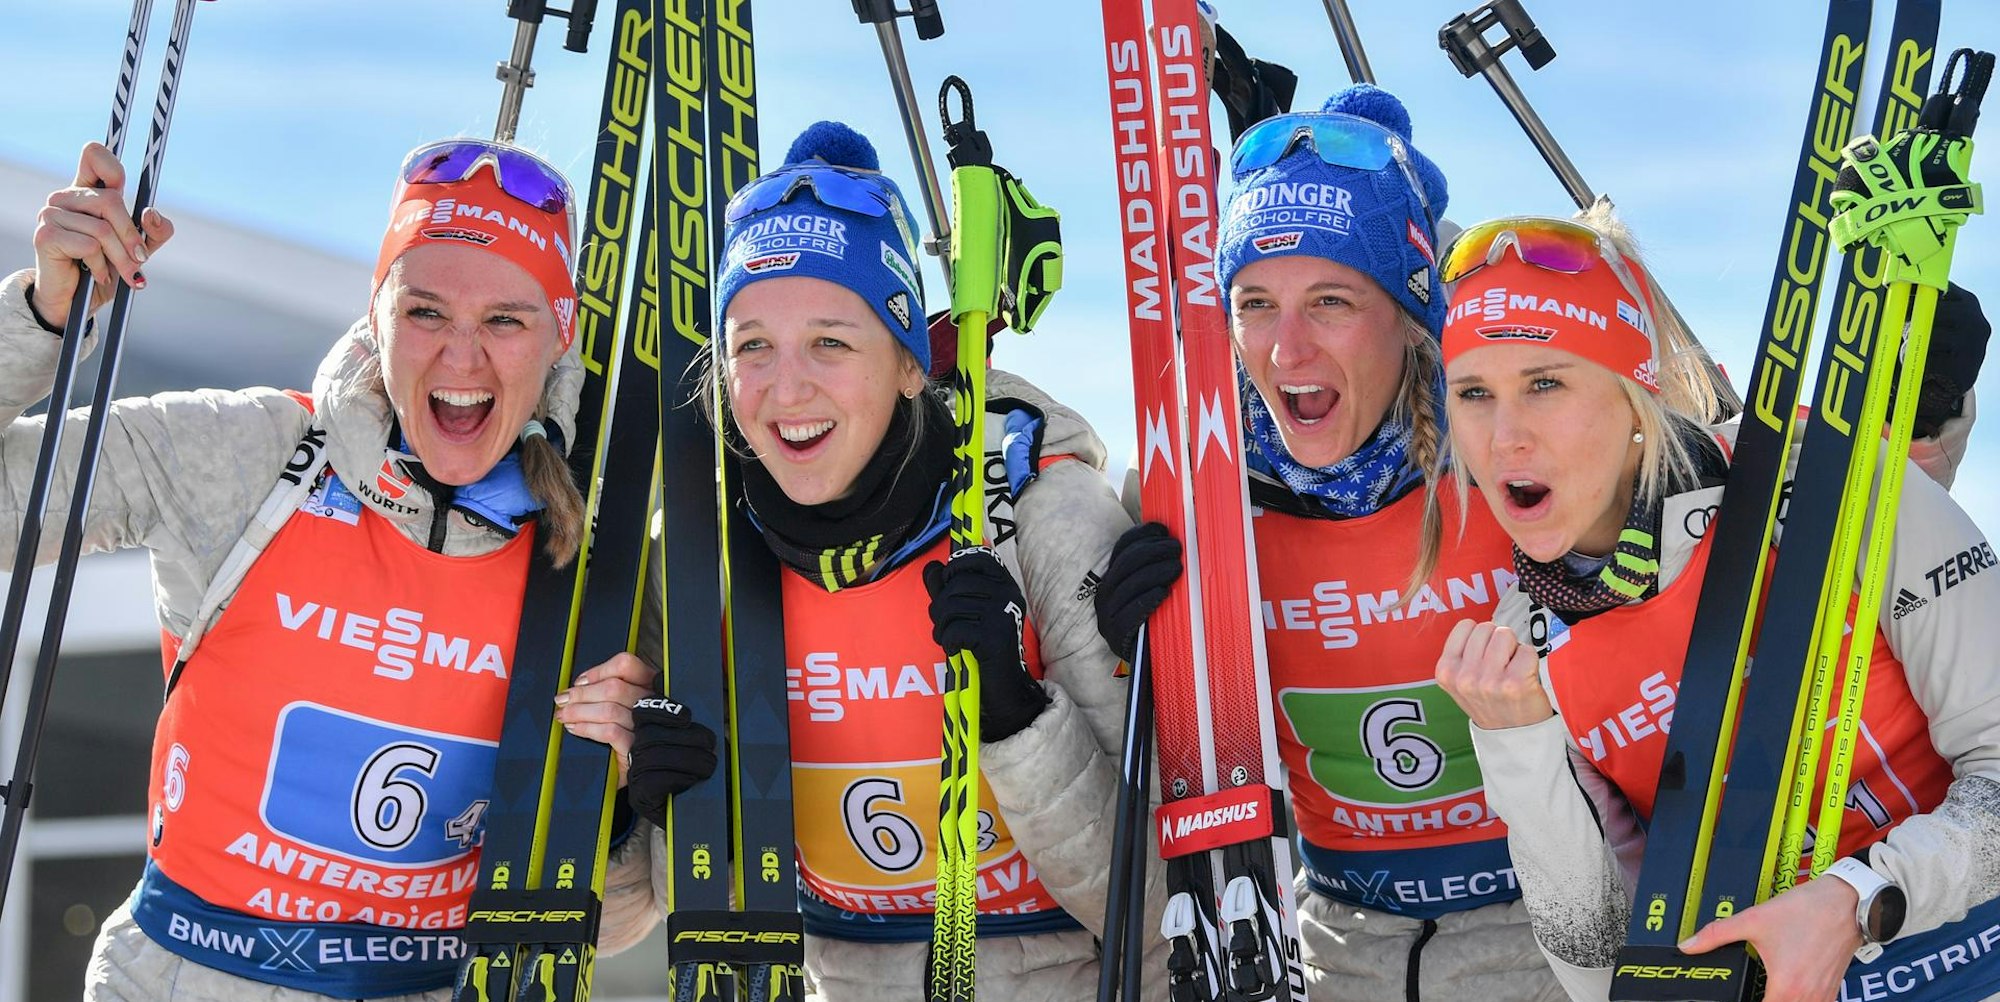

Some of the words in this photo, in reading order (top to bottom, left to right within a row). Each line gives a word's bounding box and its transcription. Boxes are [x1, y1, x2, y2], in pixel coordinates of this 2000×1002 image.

[1111, 39, 1162, 322] MADSHUS
[1162, 24, 1218, 307] MADSHUS
[579, 9, 652, 377] FISCHER
[393, 199, 547, 251] VIESSMANN
[1755, 33, 1864, 434] FISCHER
[1821, 38, 1933, 437] FISCER
[1407, 278, 1430, 303] adidas
[1445, 287, 1608, 331] VIESSMANN
[887, 299, 910, 329] adidas
[1925, 541, 1997, 598] TERRE
[1893, 597, 1929, 620] adidas
[1807, 655, 1828, 731] PREMIO
[1843, 656, 1863, 732] PREMIO
[1360, 698, 1447, 792] 6
[1799, 737, 1813, 776] SLG
[1834, 737, 1849, 777] SLG
[163, 743, 190, 812] 6
[352, 741, 442, 851] 6
[1793, 781, 1805, 807] 20
[1829, 782, 1841, 808] 20
[446, 800, 489, 848] 4
[841, 778, 925, 875] 6
[1175, 801, 1259, 838] MADSHUS
[692, 850, 711, 880] 3D
[761, 852, 780, 883] 3D
[167, 912, 256, 958] BMW
[469, 910, 586, 923] FISCHER
[674, 930, 800, 945] FISCHER
[1646, 899, 1667, 931] 3D
[1616, 963, 1732, 981] FISCHER
